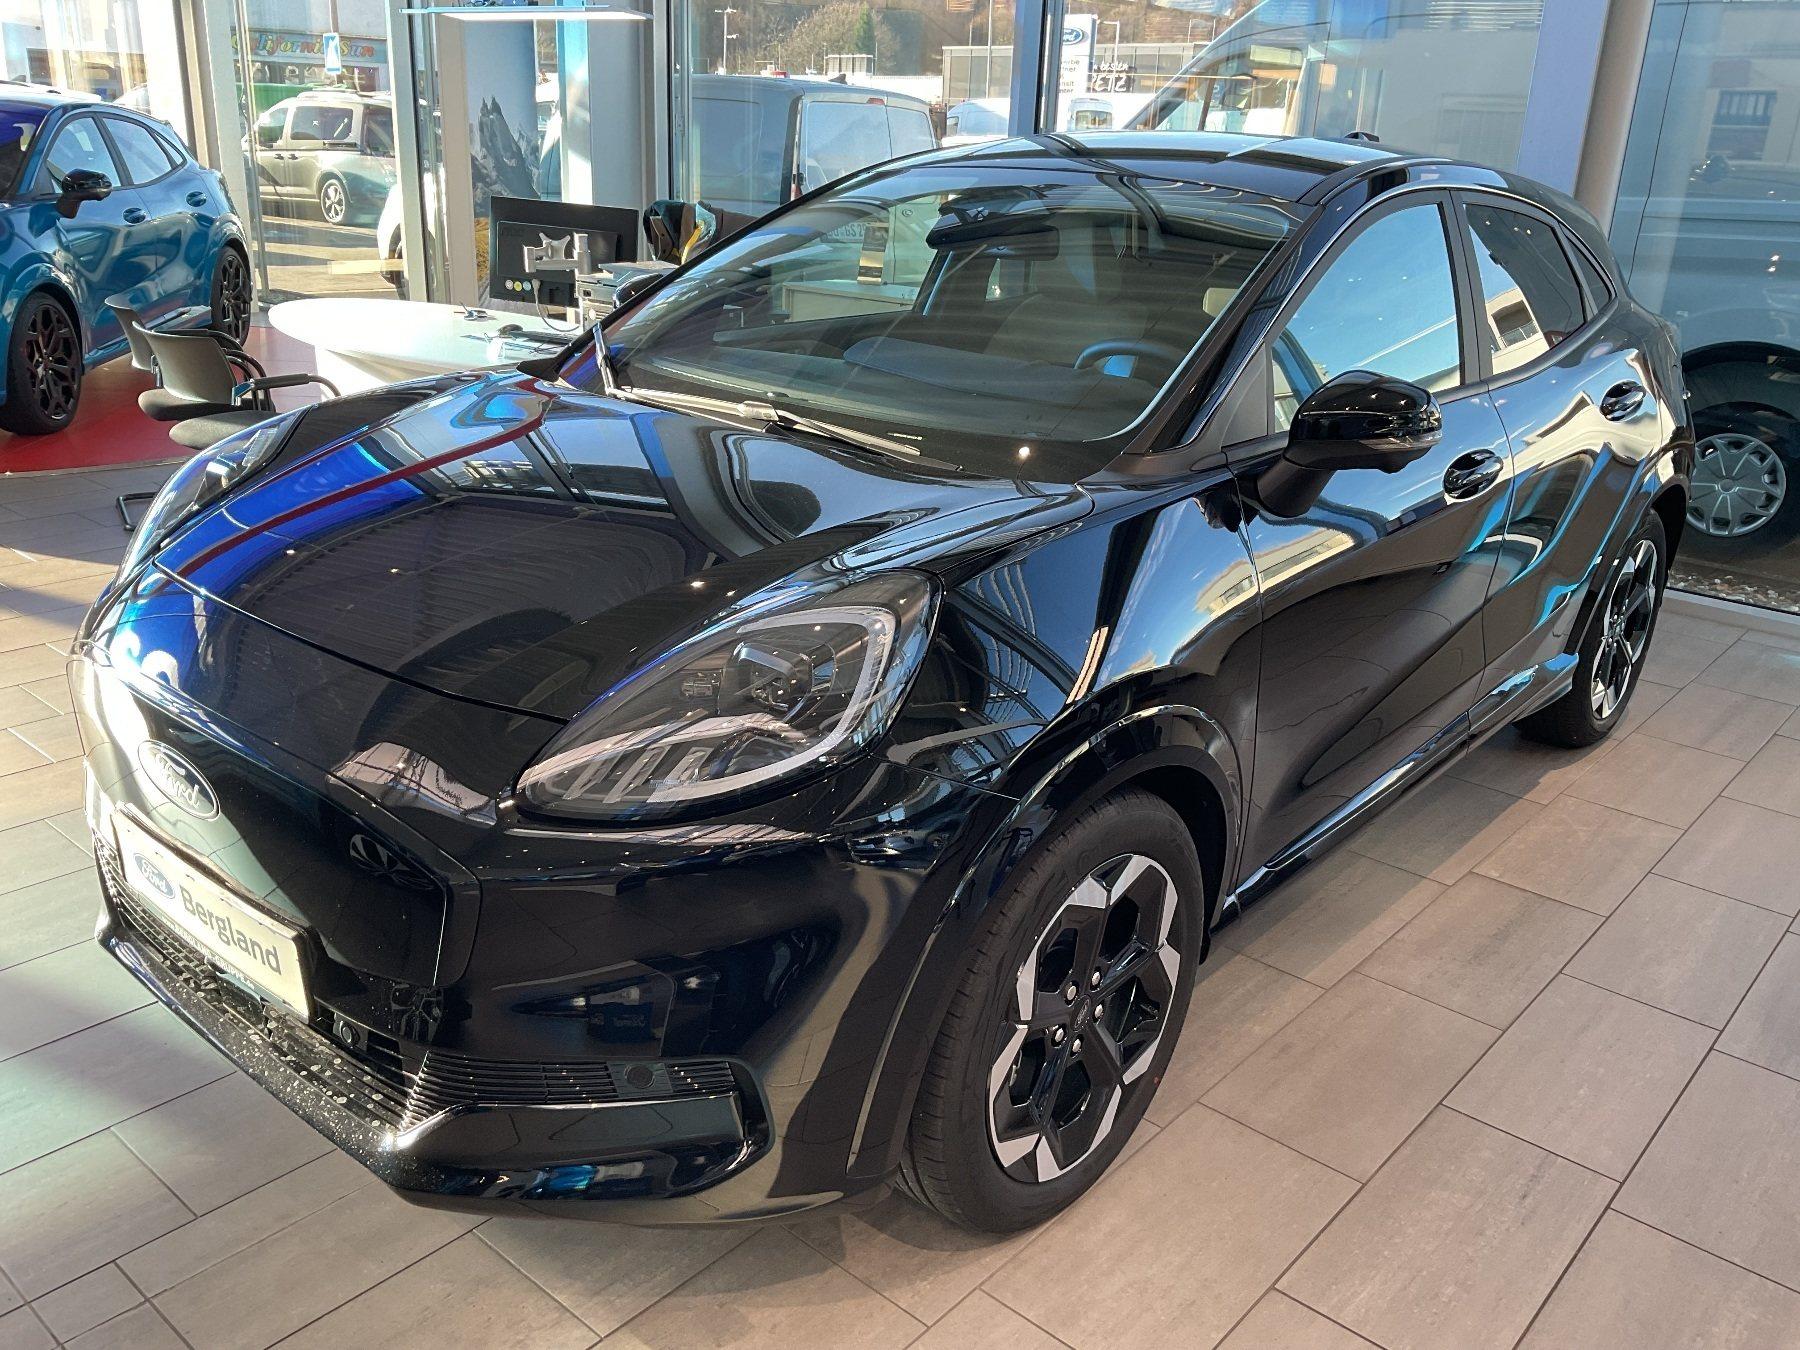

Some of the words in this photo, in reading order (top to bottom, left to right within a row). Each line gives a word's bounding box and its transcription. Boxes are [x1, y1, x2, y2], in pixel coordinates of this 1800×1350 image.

[340, 41, 375, 58] Sun
[140, 860, 167, 893] Ford
[179, 884, 282, 976] Bergland
